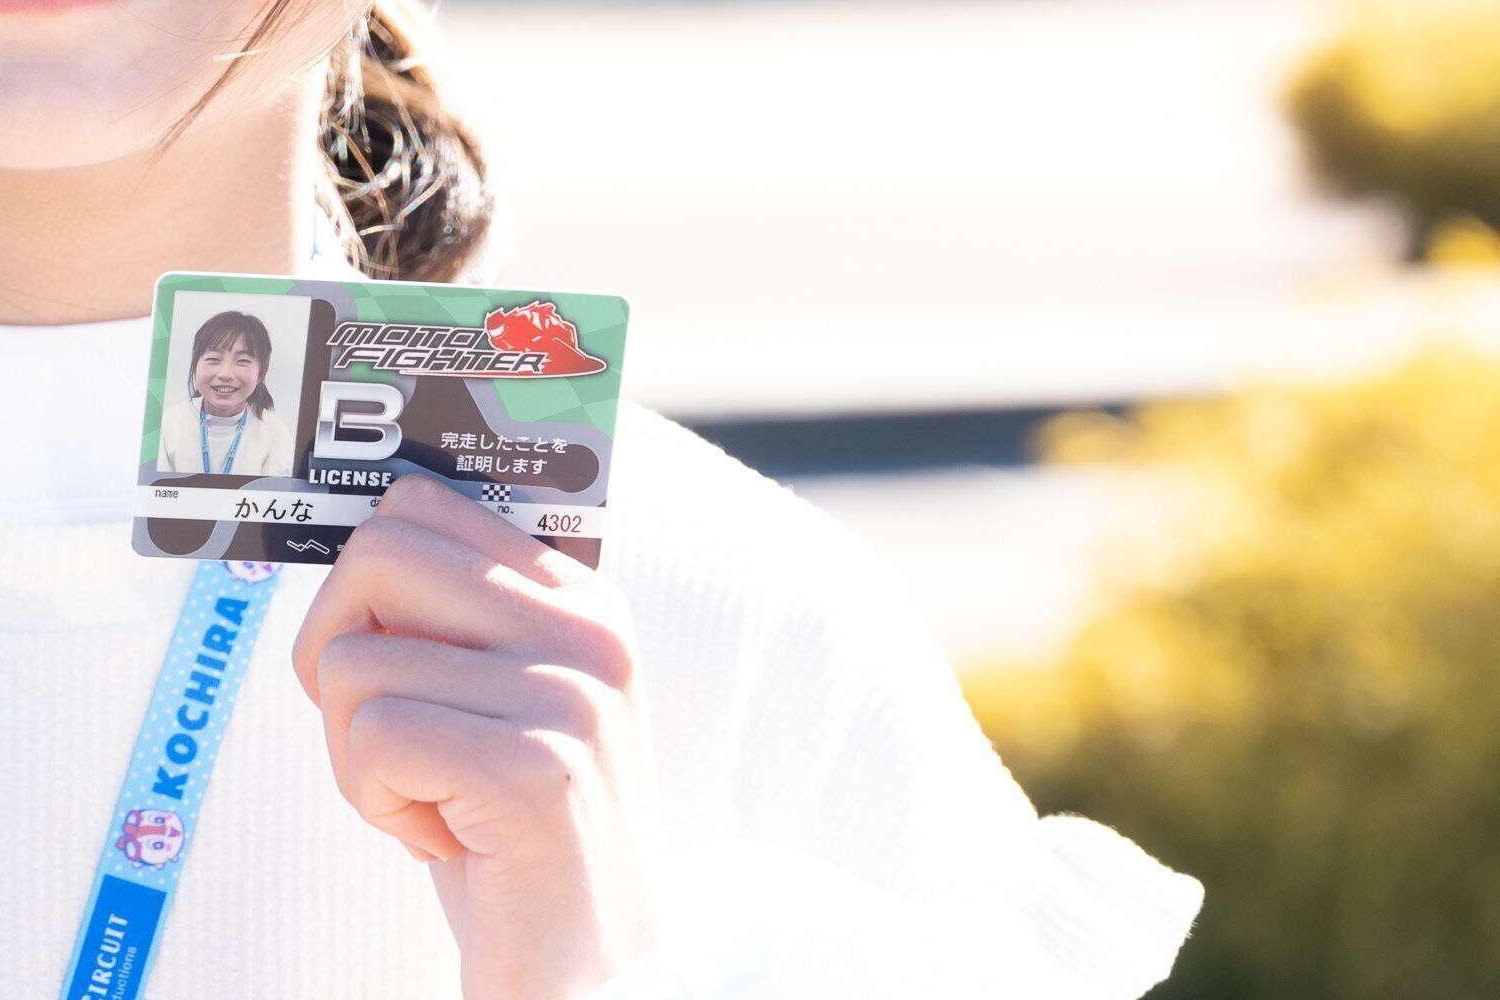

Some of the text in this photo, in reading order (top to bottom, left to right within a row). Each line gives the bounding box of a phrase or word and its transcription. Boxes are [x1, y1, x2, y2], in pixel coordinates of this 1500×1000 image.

[326, 321, 487, 350] MOTO
[333, 346, 548, 374] FIGHTER
[313, 380, 404, 460] B
[440, 432, 568, 454] 完走したことを
[309, 468, 392, 487] LICENSE
[456, 455, 548, 475] 証明します
[154, 488, 179, 499] name
[234, 497, 314, 522] かんな
[497, 505, 582, 533] no. 4302
[151, 597, 249, 801] KOCHIRA
